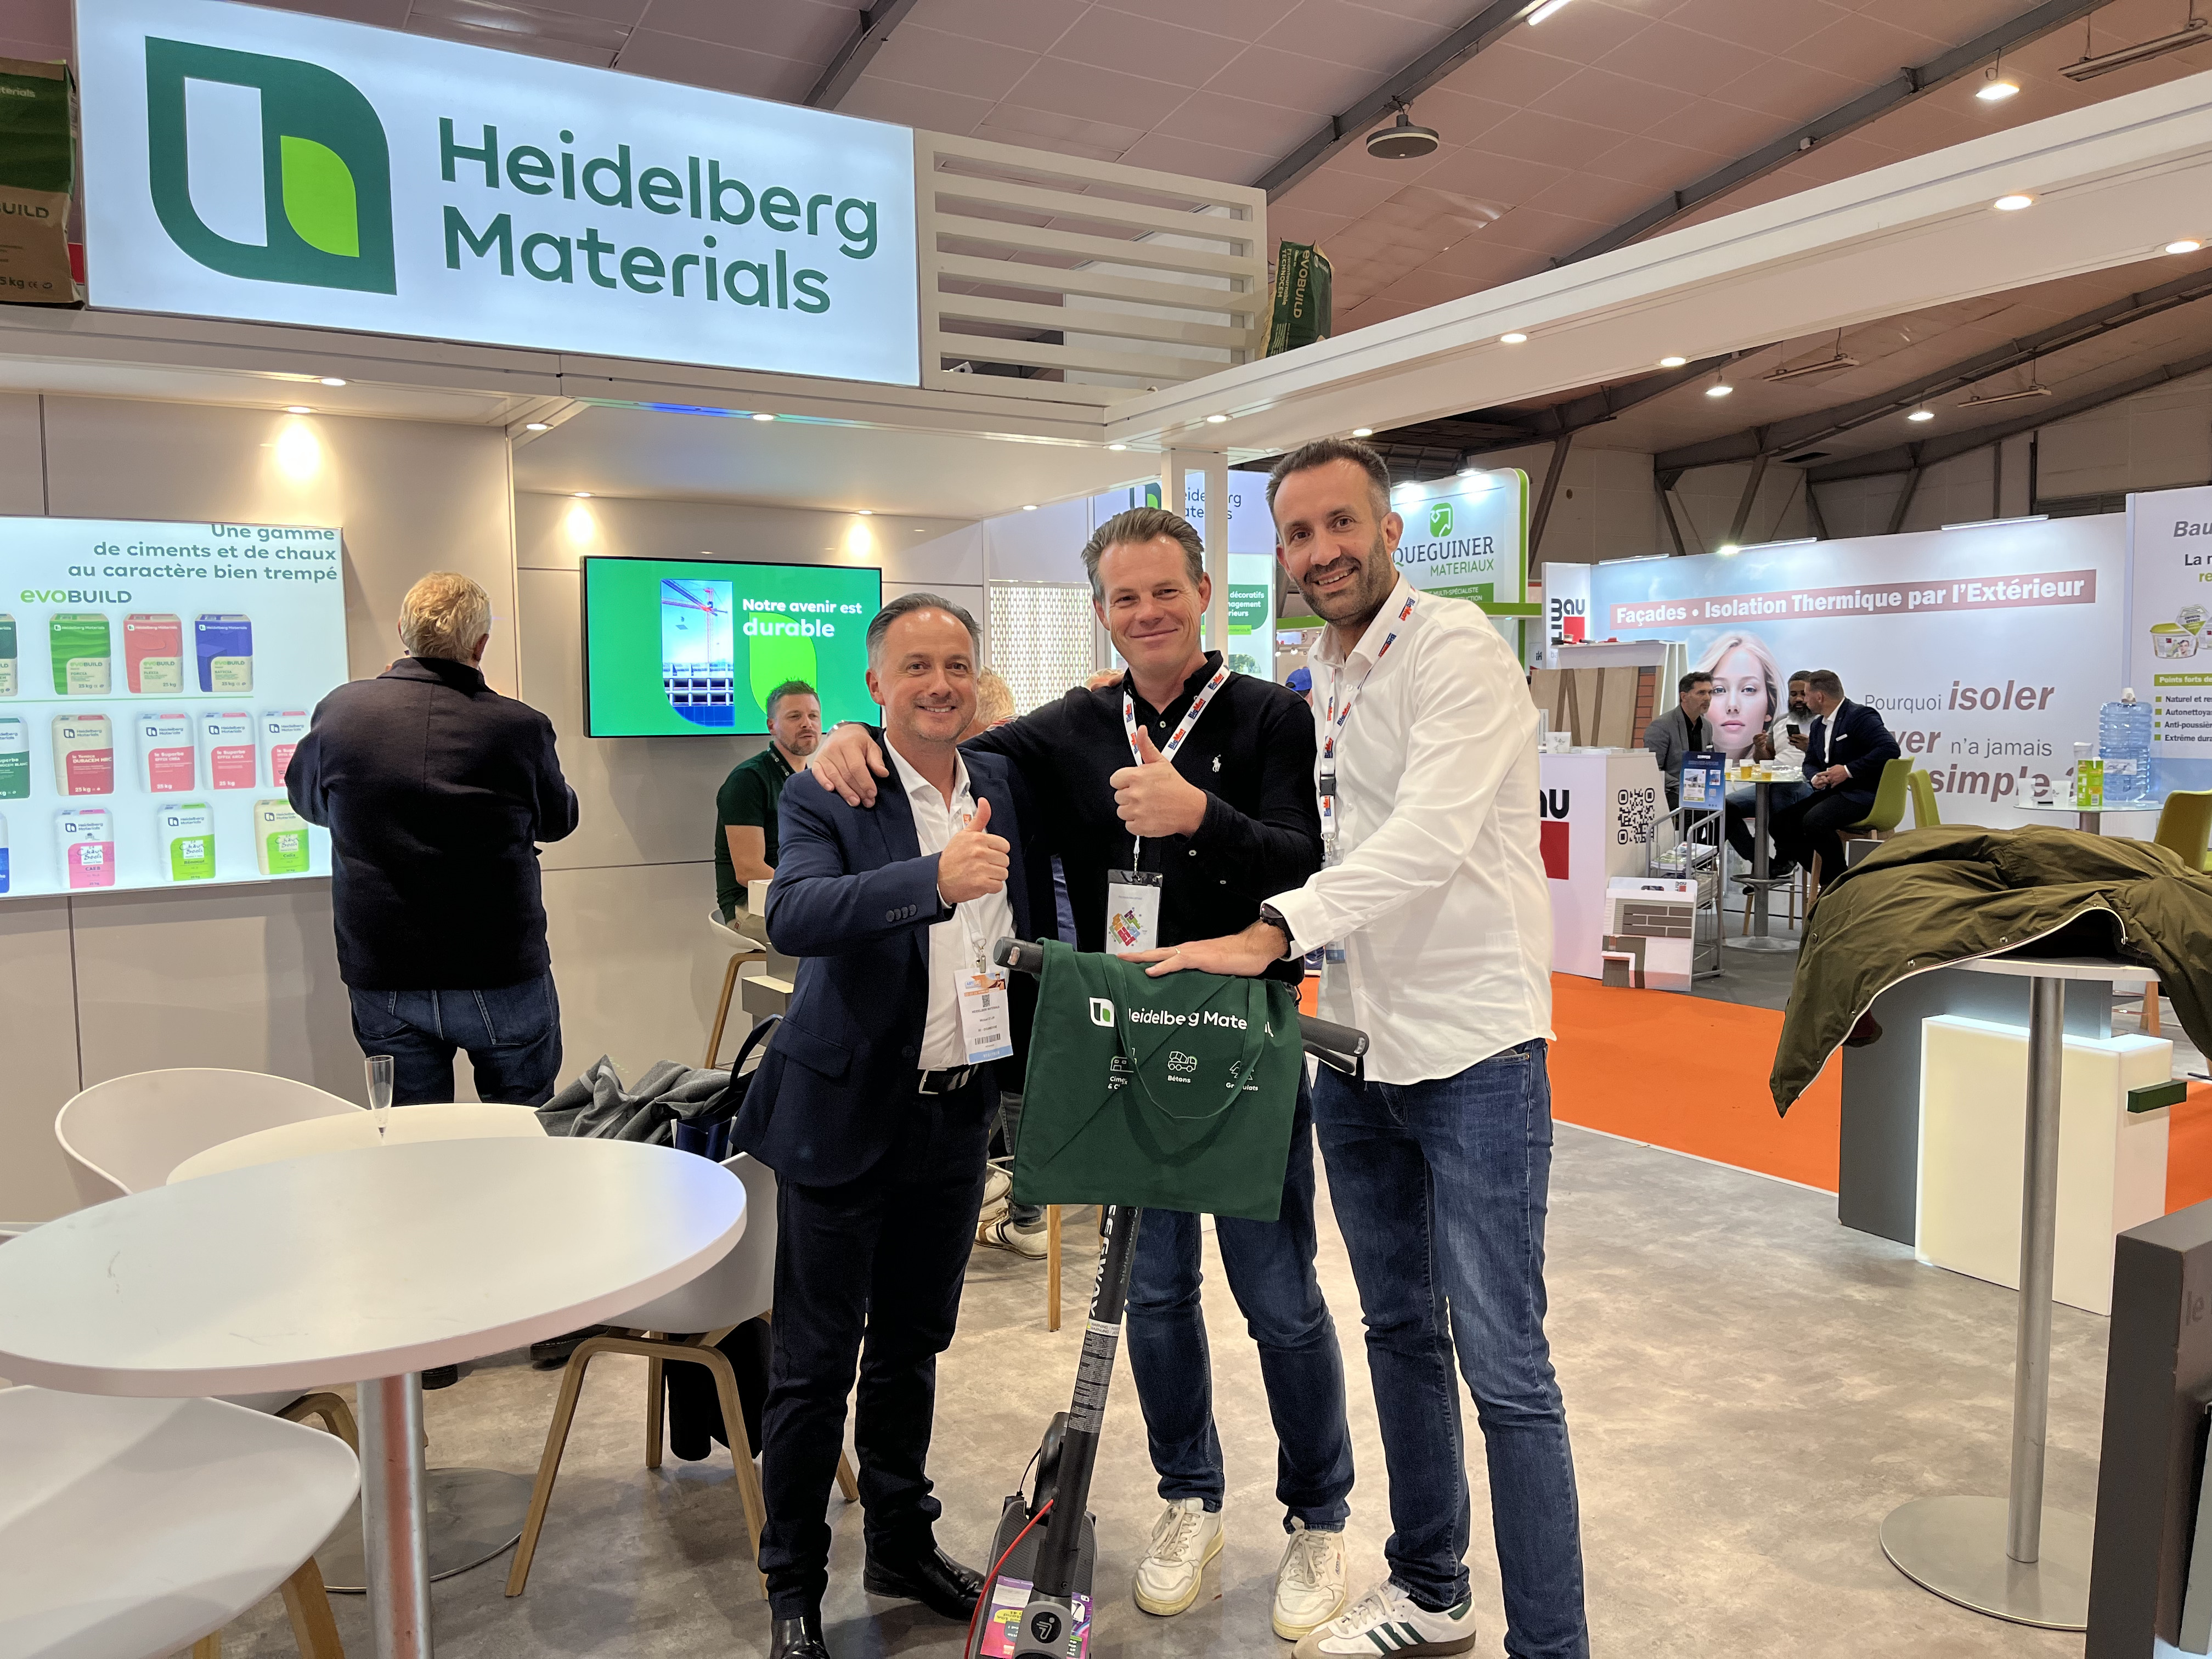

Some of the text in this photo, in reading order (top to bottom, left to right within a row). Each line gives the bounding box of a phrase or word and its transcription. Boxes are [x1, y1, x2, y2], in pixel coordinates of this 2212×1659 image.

[439, 117, 877, 259] Heidelberg
[0, 202, 49, 218] UILD
[443, 205, 831, 314] Materials
[211, 523, 335, 542] Une gamme
[2174, 521, 2212, 537] Bau
[94, 541, 336, 561] de ciments et de chaux
[1392, 536, 1494, 567] QUEGUINER
[2185, 554, 2202, 566] La
[68, 563, 337, 583] au caractère bien trempé
[1431, 558, 1494, 577] MATERIAUX
[20, 589, 132, 603] evoBUILD
[743, 599, 862, 614] Notre avenir est
[1399, 596, 1415, 621] BigMat
[1617, 605, 1687, 626] Façades
[1705, 596, 1787, 618] Isolation
[1791, 590, 1902, 612] Thermique
[1908, 589, 1946, 609] par
[743, 618, 835, 637] durable
[1865, 680, 2055, 714] Pourquoi isoler
[1188, 698, 1206, 720] BigMat
[1168, 728, 1186, 751] BigMat
[1984, 738, 2052, 758] jamais
[1128, 1008, 1199, 1027] eidelbeg
[1167, 1075, 1191, 1084] Bétons
[1226, 1082, 1259, 1091] Grulats
